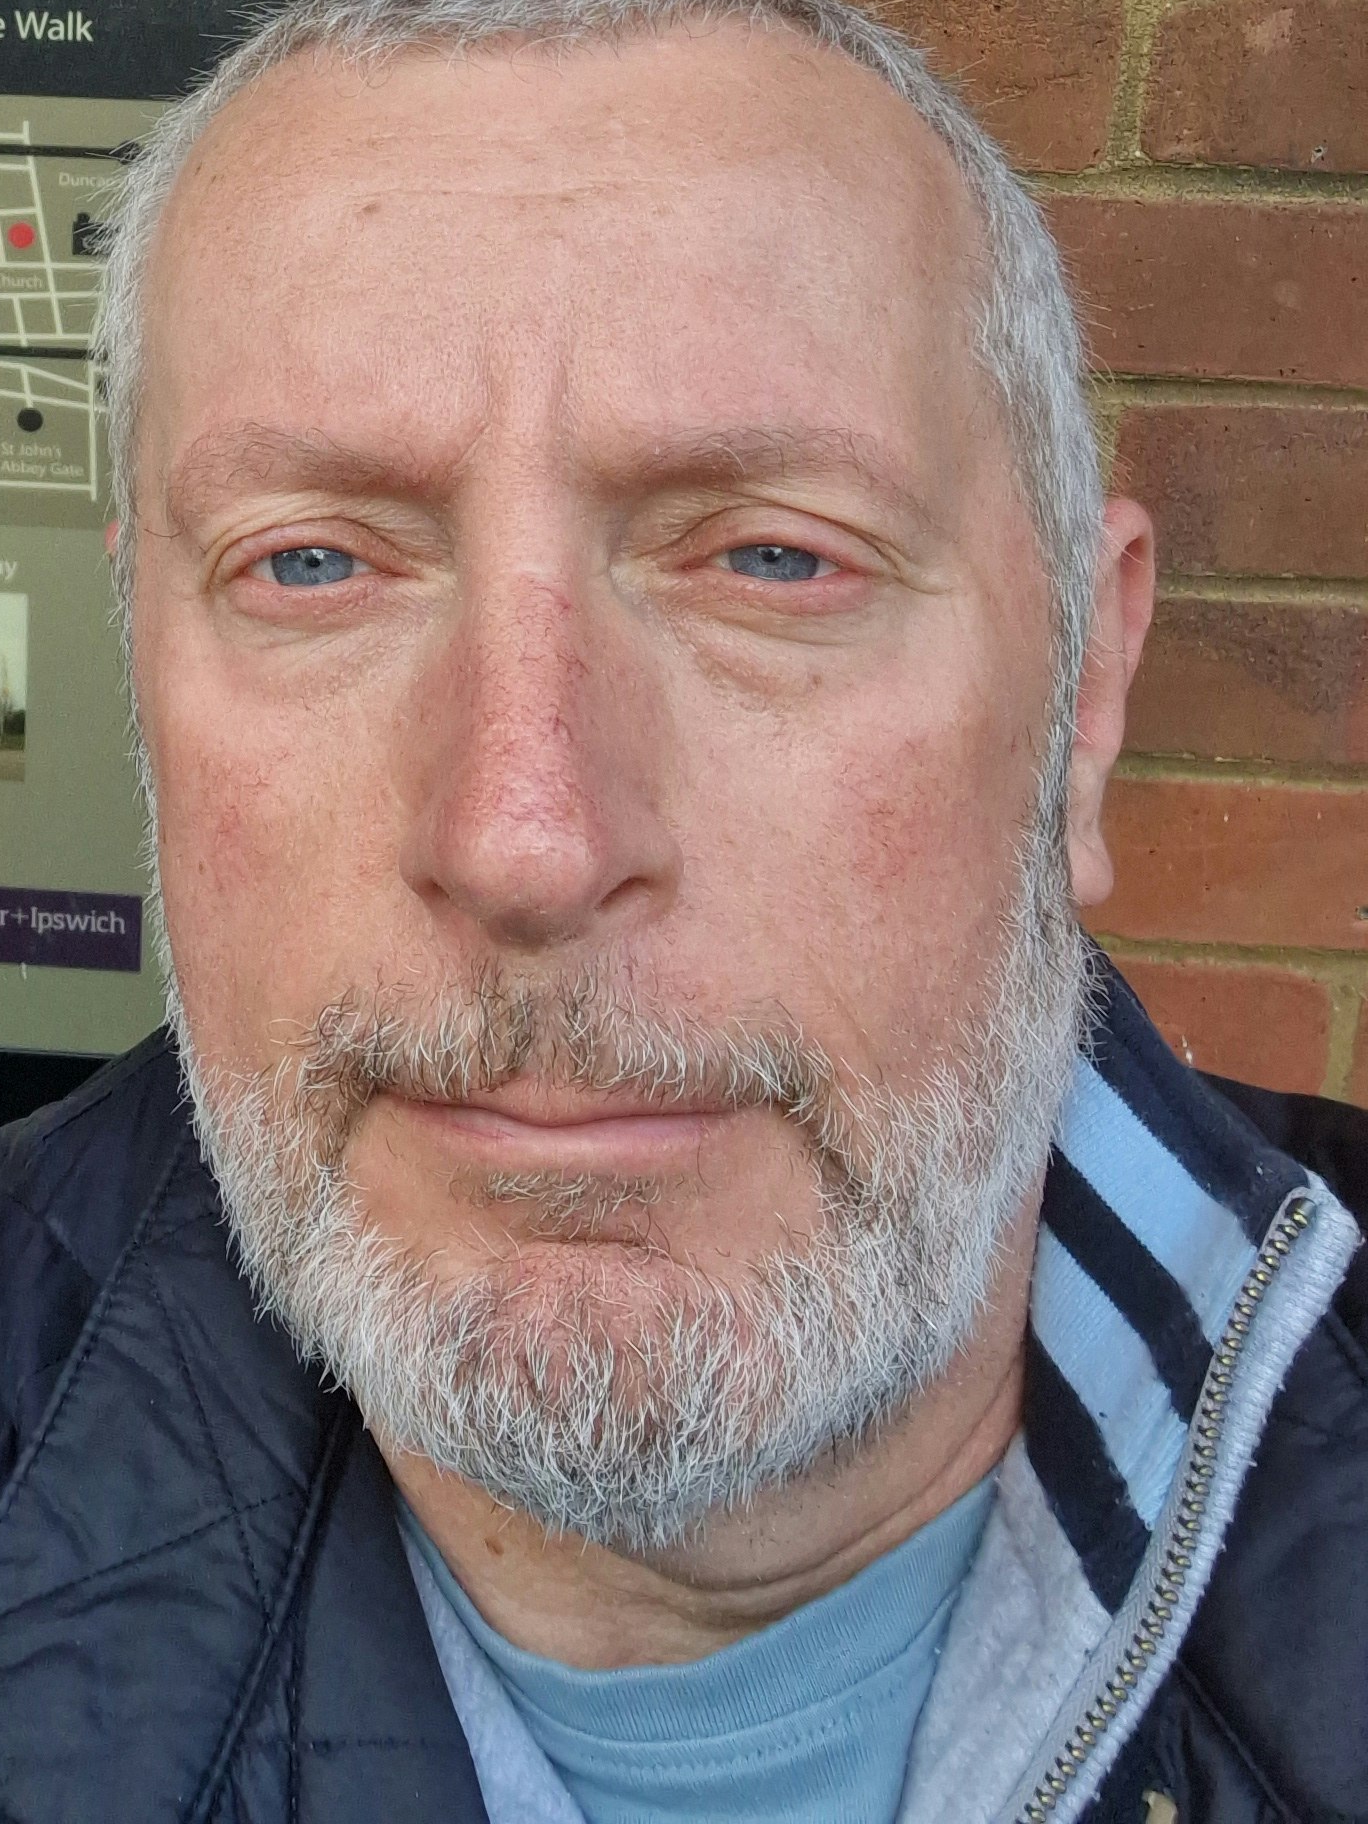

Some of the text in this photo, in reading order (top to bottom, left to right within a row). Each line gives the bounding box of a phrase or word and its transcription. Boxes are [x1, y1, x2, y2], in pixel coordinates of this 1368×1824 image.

[14, 9, 95, 44] Walk
[1, 442, 63, 459] St John's
[1, 460, 85, 477] Abbey Gate
